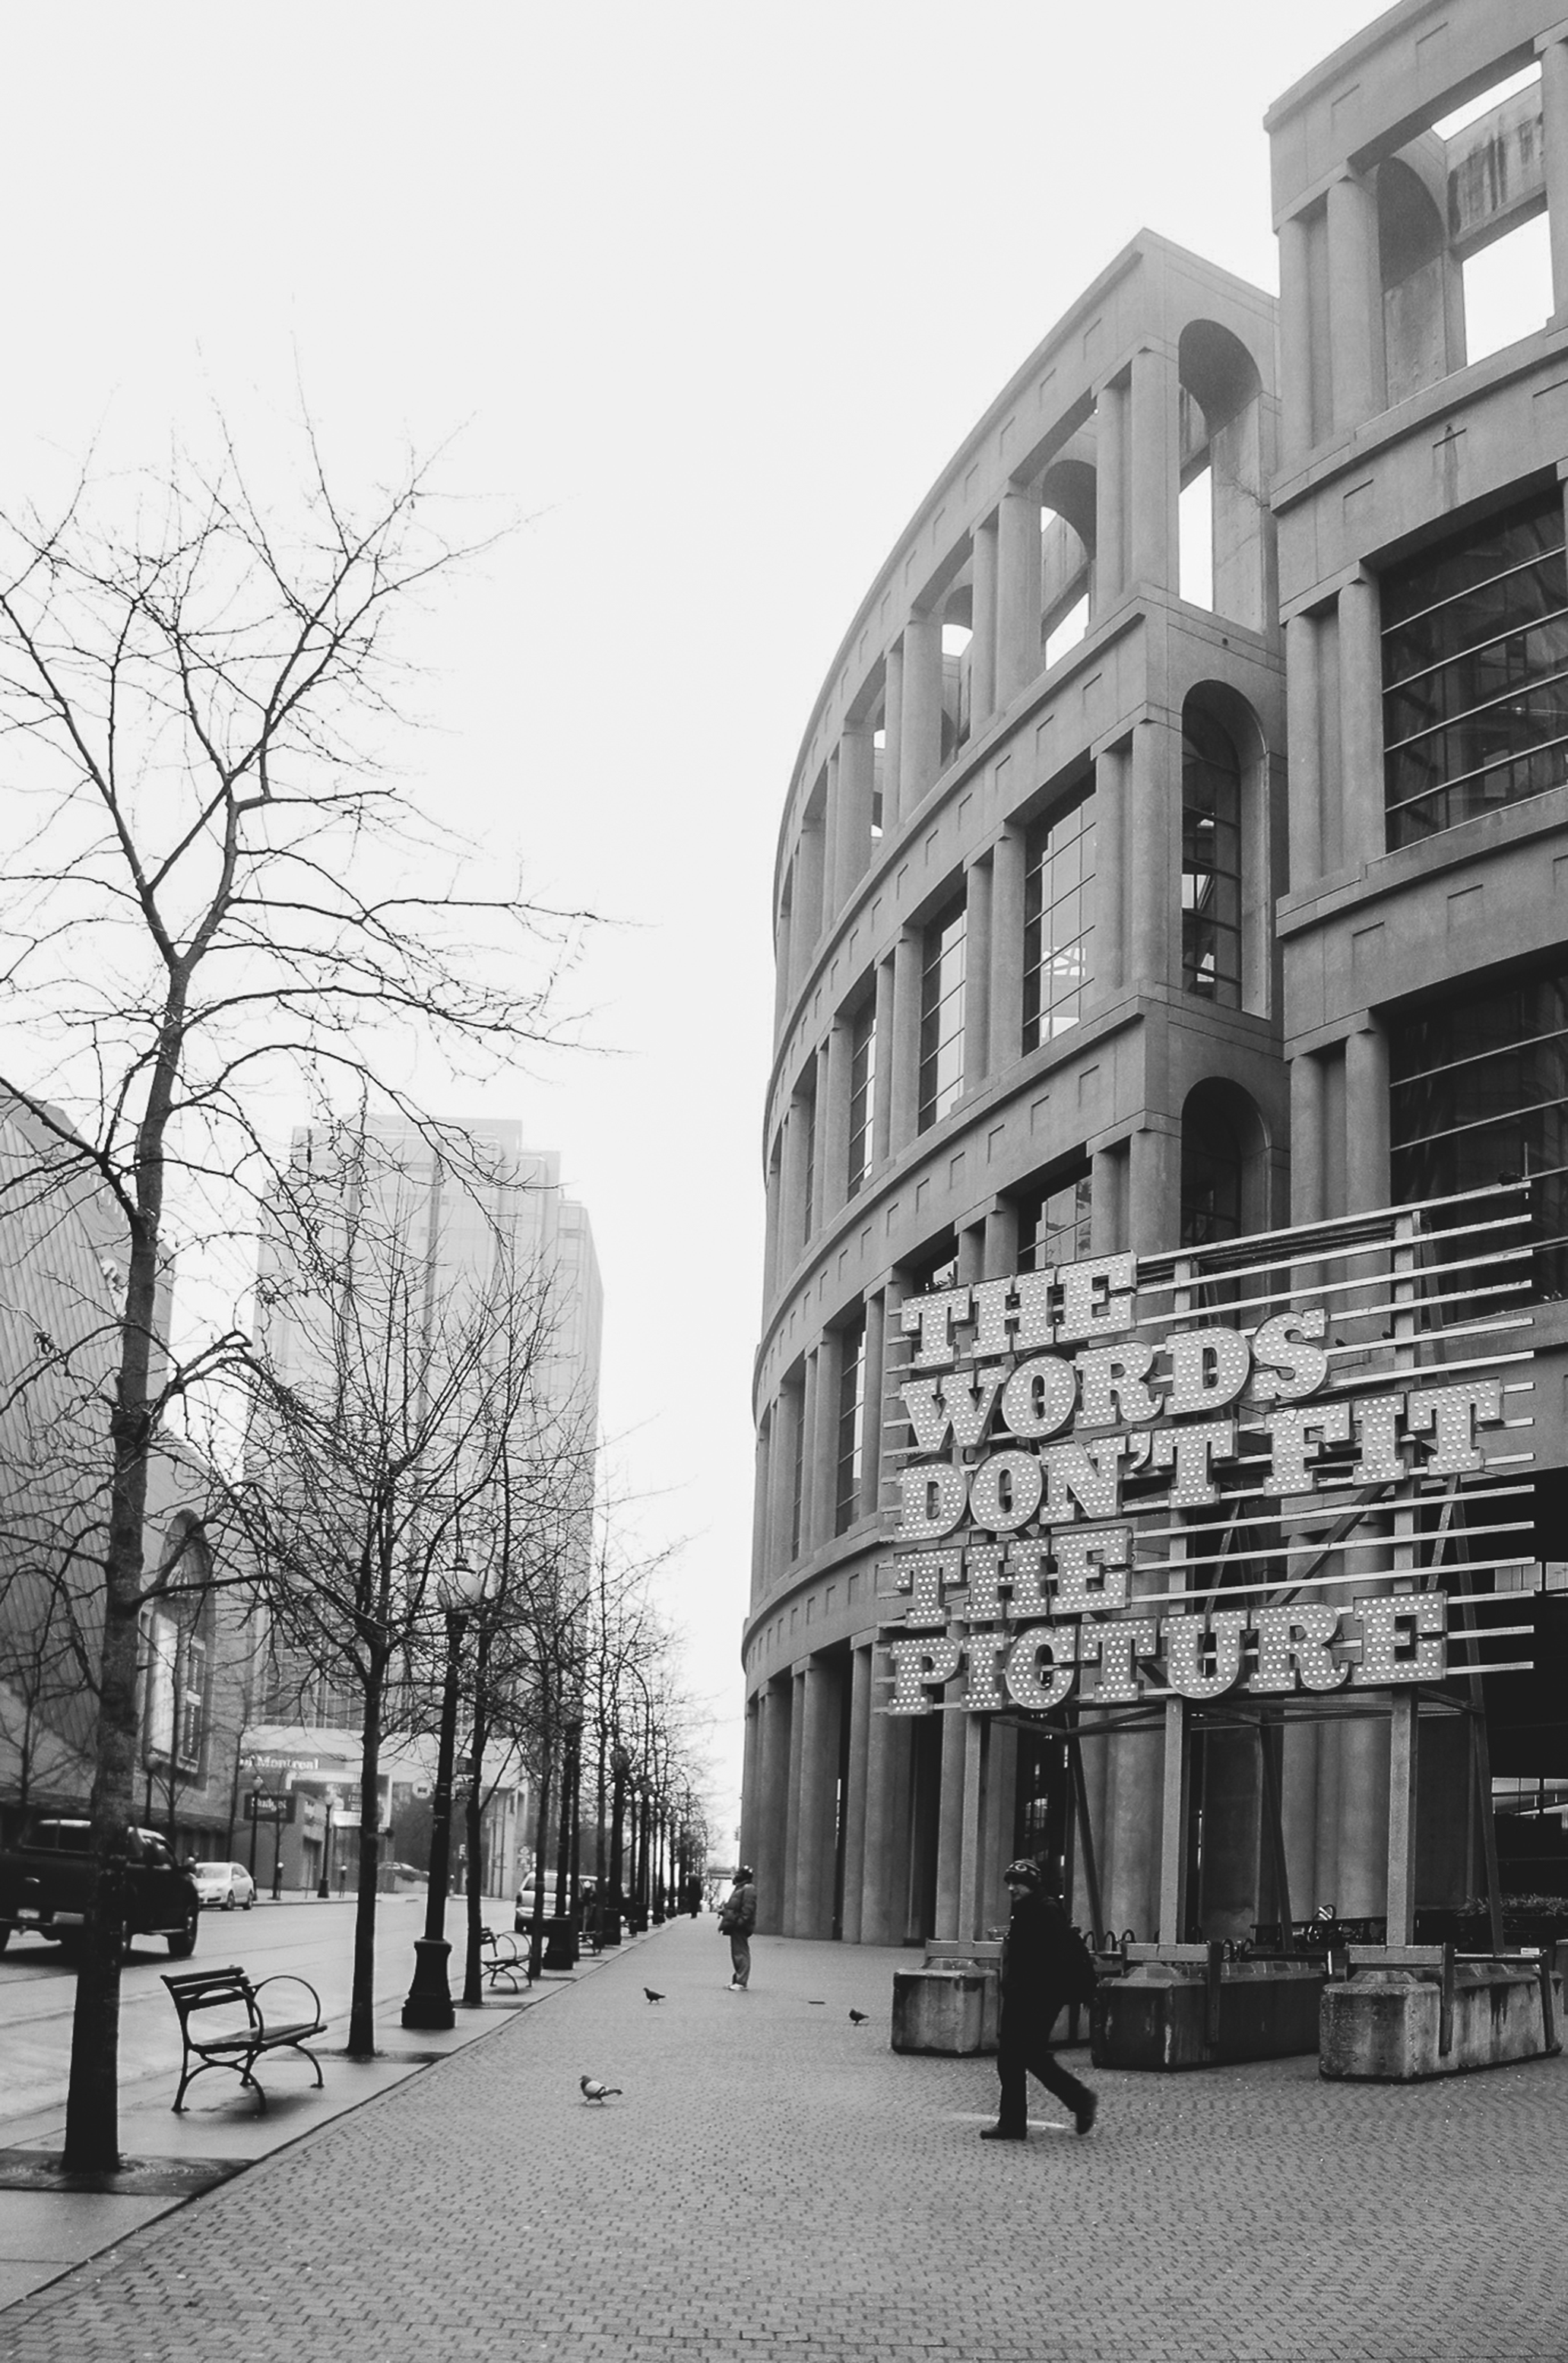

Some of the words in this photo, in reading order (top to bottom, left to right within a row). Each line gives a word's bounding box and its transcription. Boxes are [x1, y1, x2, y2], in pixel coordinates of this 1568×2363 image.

[901, 1251, 1136, 1367] THE
[901, 1308, 1328, 1451] WORDS
[895, 1419, 1237, 1542] DON'T
[1263, 1377, 1501, 1496] FIT
[893, 1518, 1132, 1628] THE
[889, 1591, 1446, 1715] PICTURE
[256, 1754, 318, 1770] Montreal
